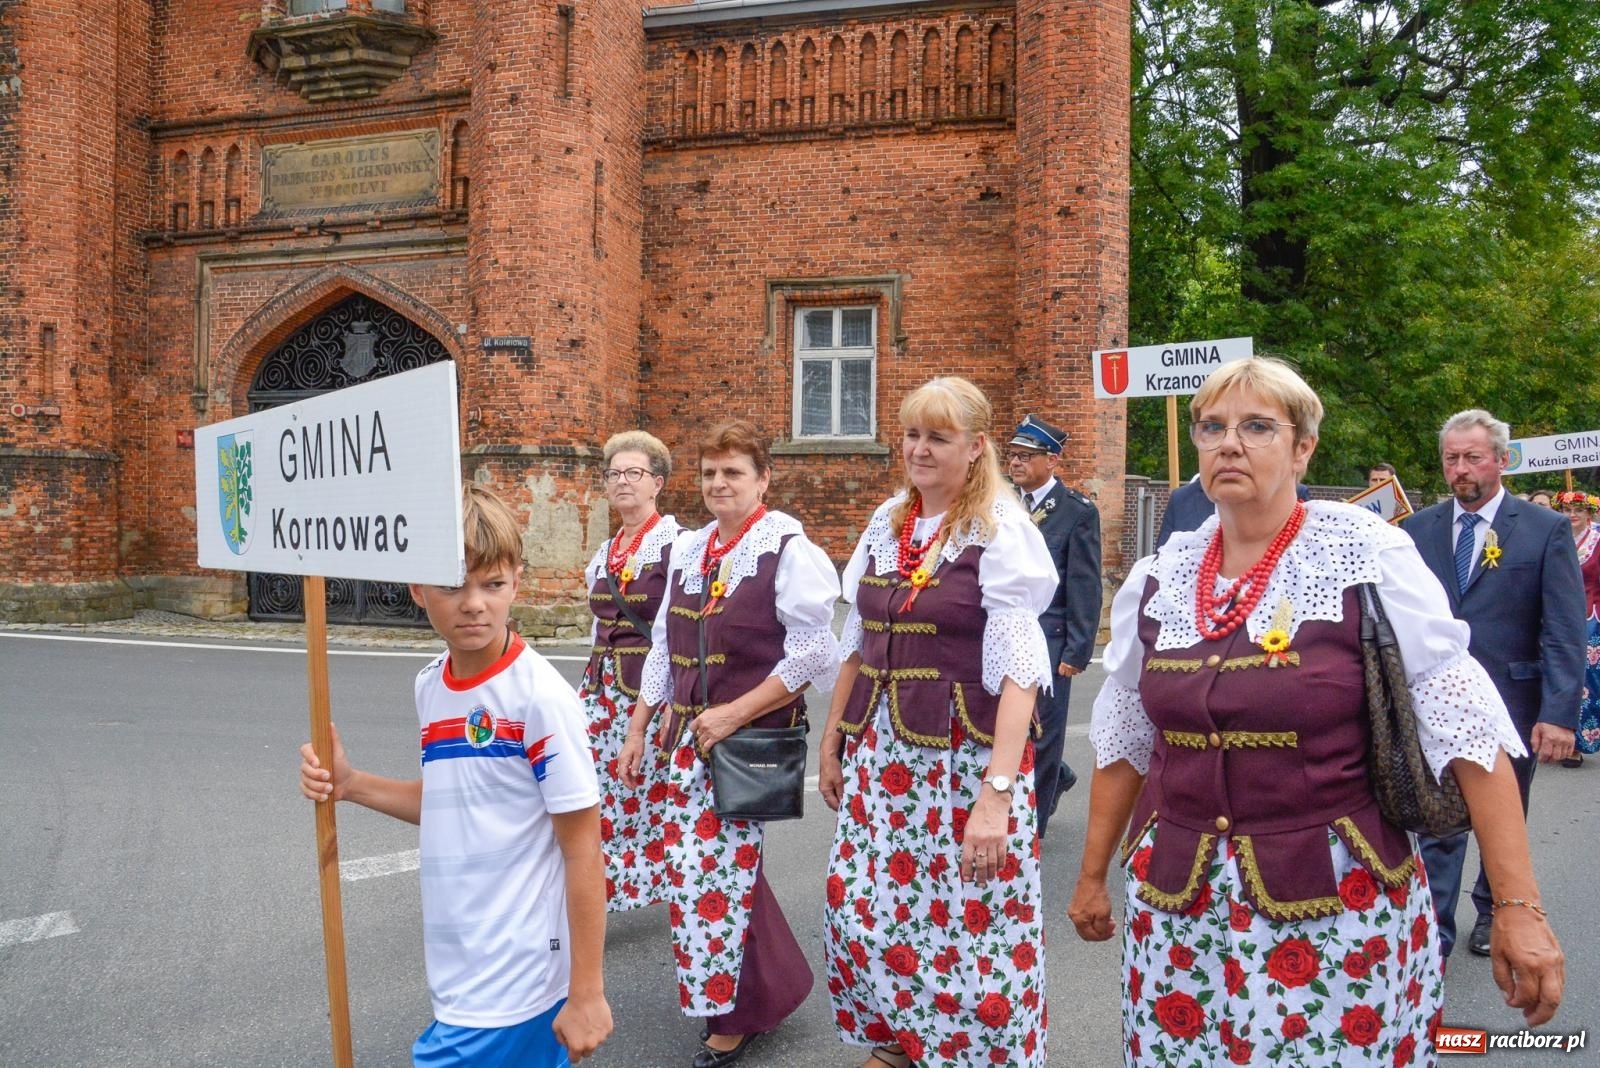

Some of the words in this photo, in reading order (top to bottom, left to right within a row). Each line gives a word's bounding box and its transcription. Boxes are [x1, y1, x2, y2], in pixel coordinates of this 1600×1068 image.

[1161, 345, 1222, 367] GMINA
[279, 410, 392, 483] GMINA
[1554, 435, 1600, 451] GMIN
[1528, 456, 1569, 468] Kuźnia
[1572, 452, 1600, 463] Raci
[272, 508, 409, 552] Kornowac
